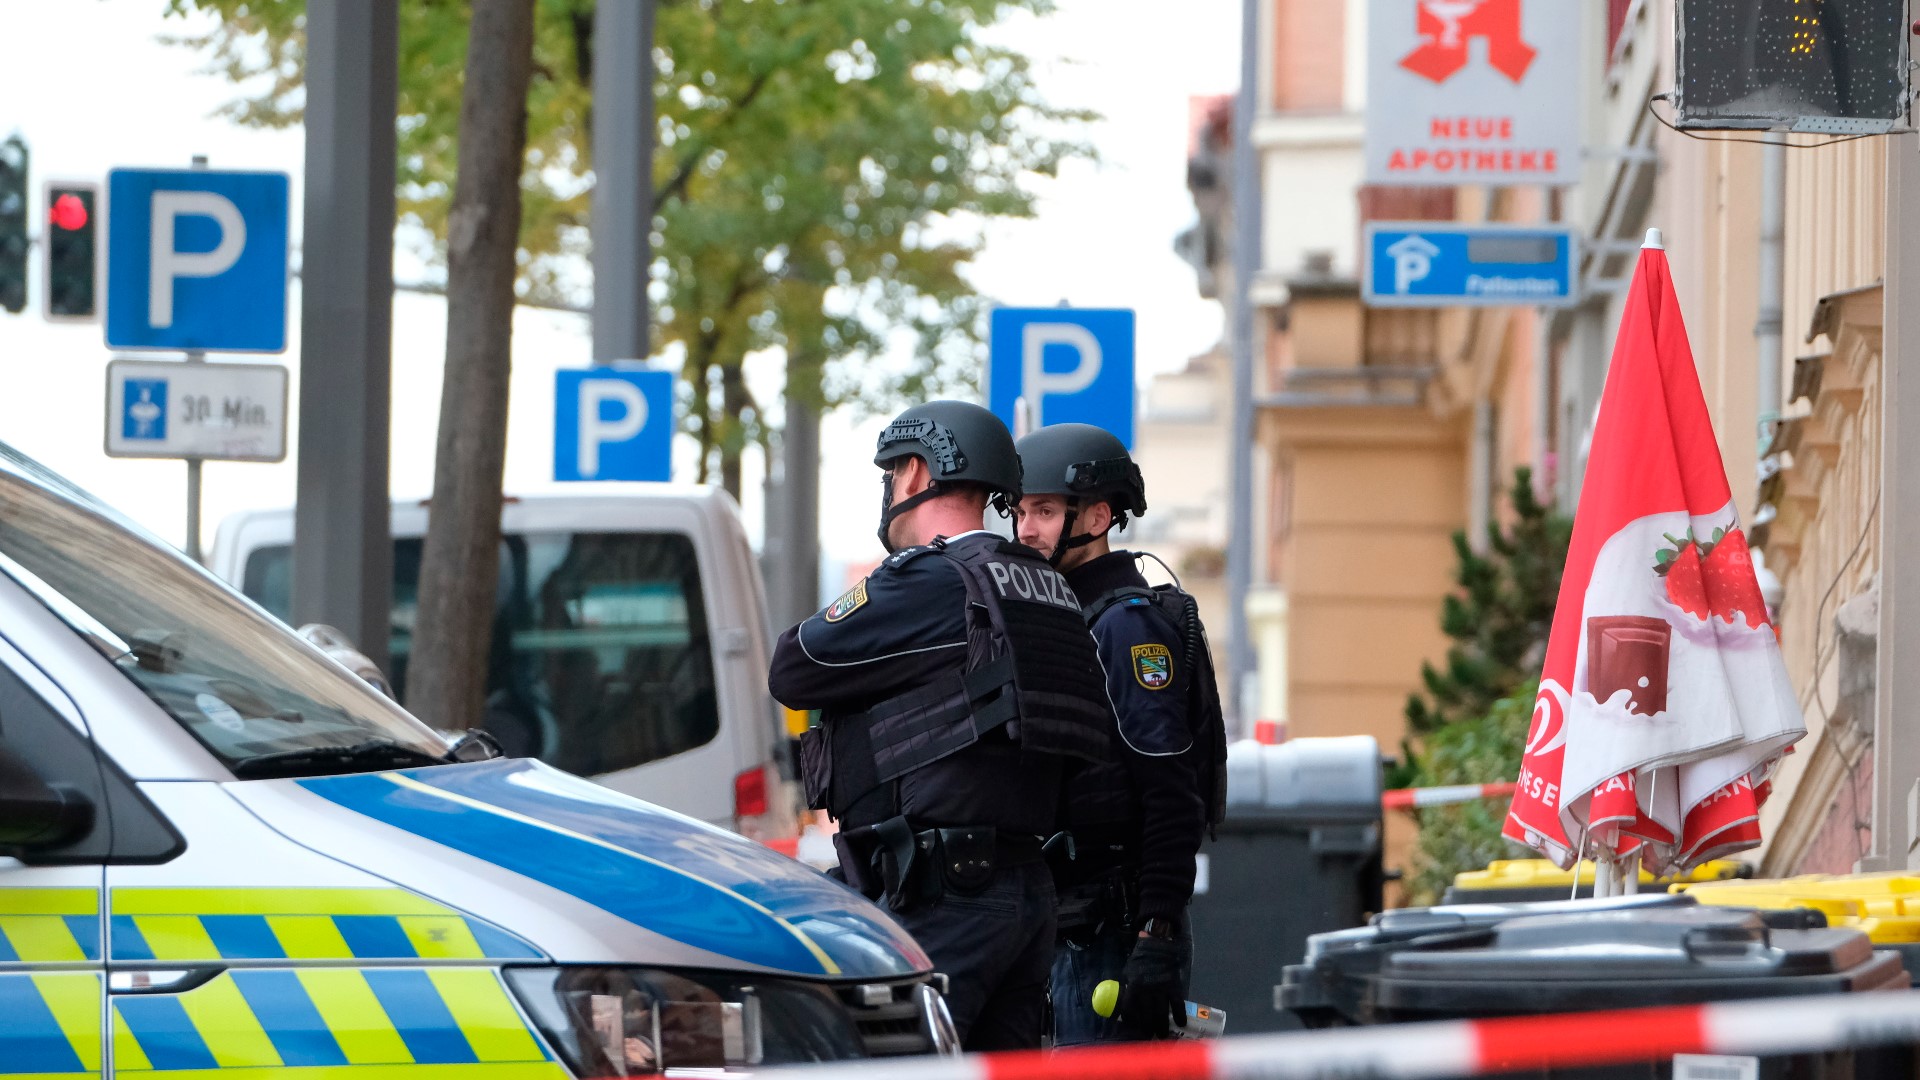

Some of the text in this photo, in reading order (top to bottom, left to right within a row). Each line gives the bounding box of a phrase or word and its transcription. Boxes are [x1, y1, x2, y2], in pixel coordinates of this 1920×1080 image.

[1430, 117, 1513, 140] NEUE
[1387, 148, 1557, 174] APOTHEKE
[149, 189, 247, 329] P
[1021, 321, 1103, 435] P
[181, 394, 211, 425] 30
[577, 378, 650, 477] P
[1134, 646, 1169, 659] POLIZEI
